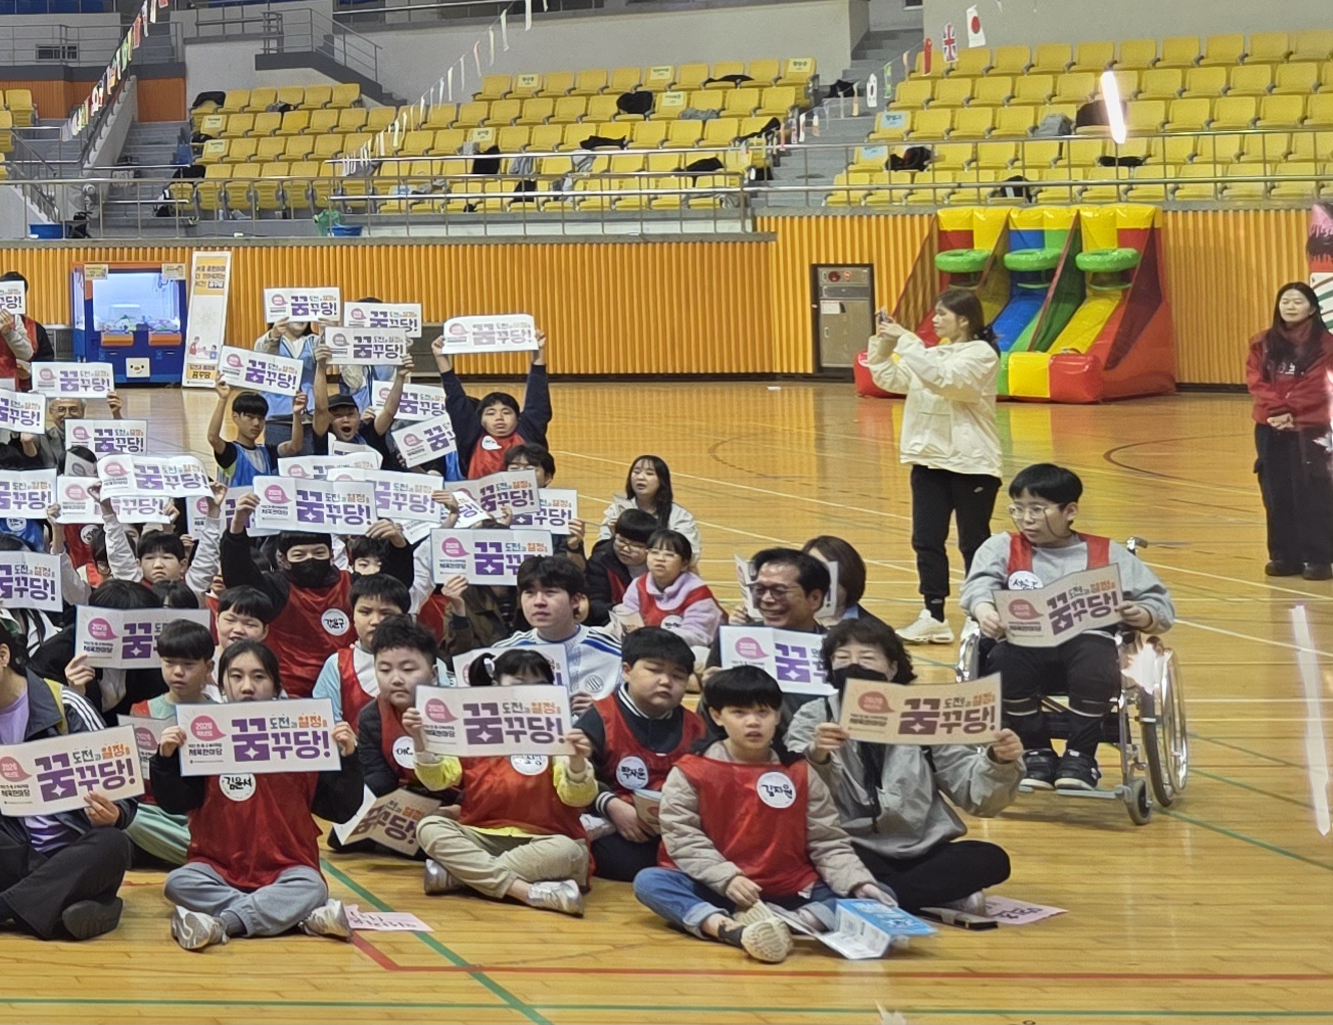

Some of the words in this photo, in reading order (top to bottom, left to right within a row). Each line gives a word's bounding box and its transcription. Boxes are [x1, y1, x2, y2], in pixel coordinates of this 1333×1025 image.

[295, 489, 371, 526] 꿈꾸당!
[463, 703, 565, 745] 꿈꾸당!
[898, 697, 996, 736] 꿈꾸당!
[232, 718, 331, 762] 꿈꾸당!
[36, 753, 136, 803] 꿈꾸당!
